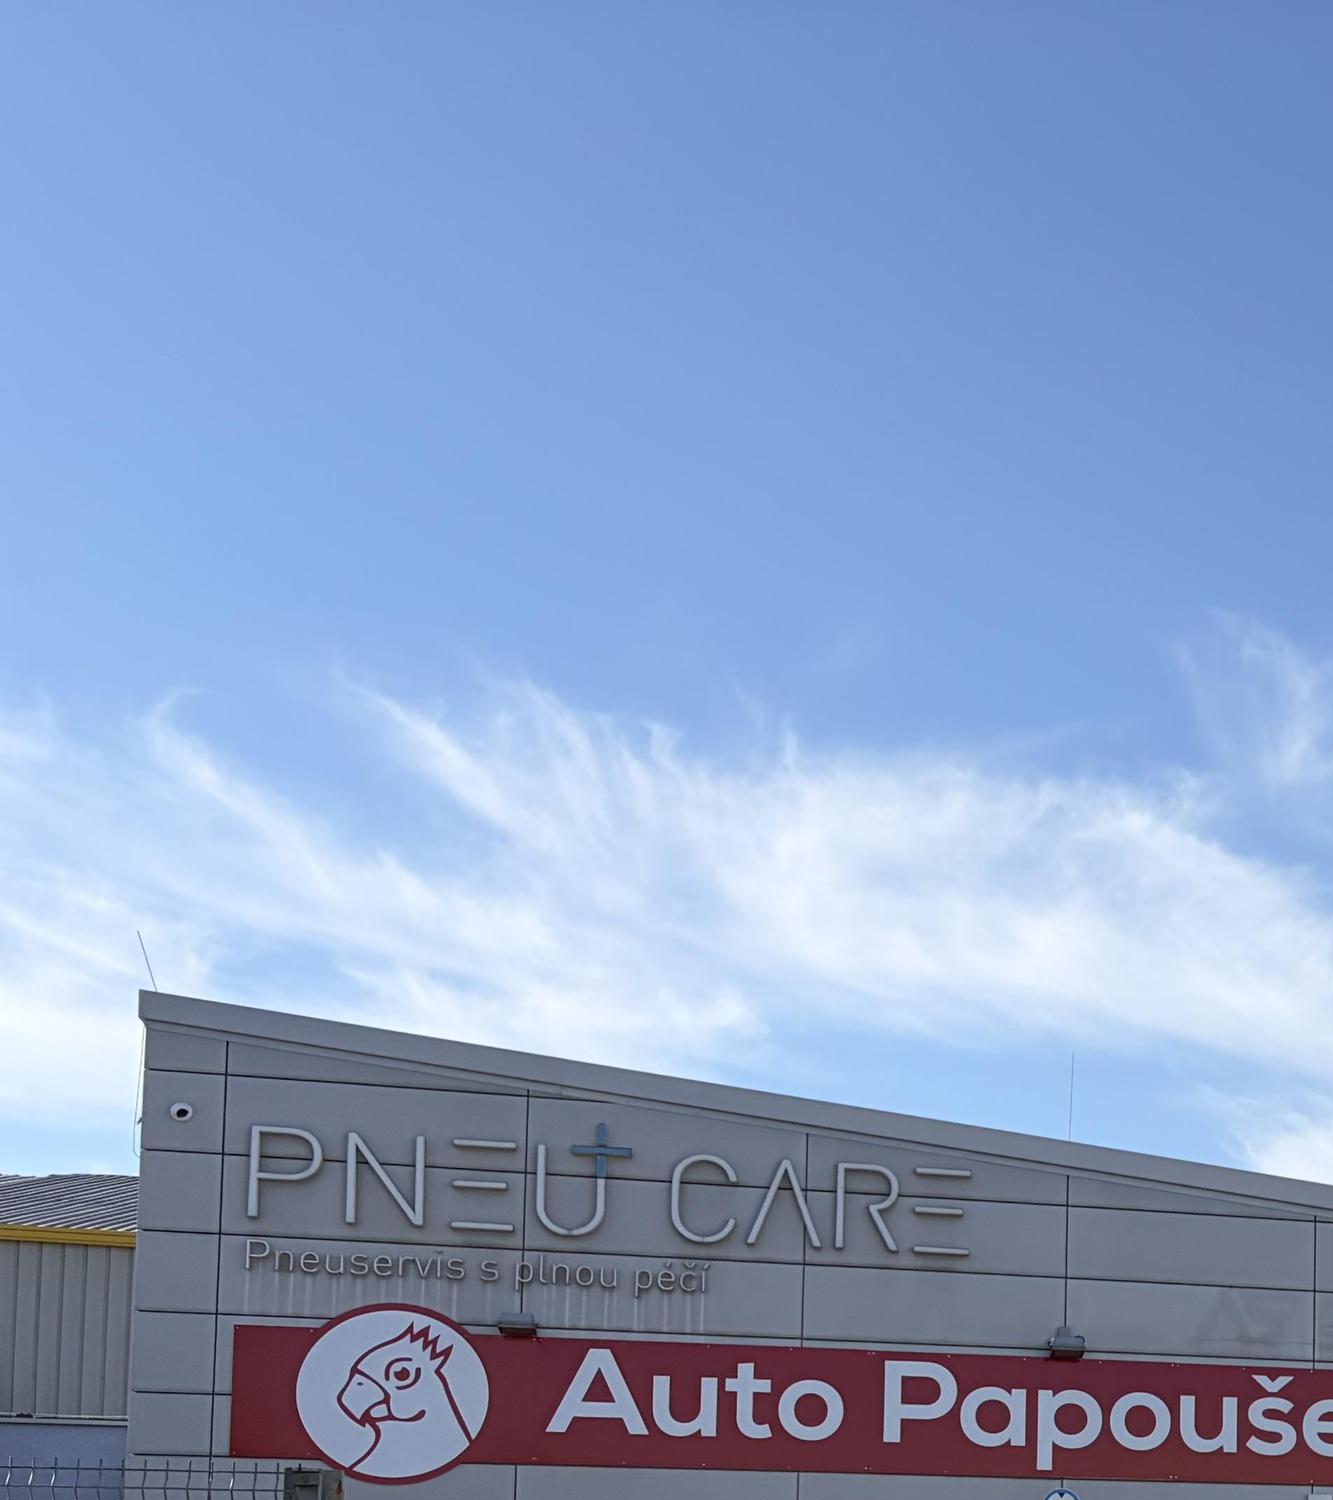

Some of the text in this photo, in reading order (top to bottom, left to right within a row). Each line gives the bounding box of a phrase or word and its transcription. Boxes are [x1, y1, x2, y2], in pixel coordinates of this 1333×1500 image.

[247, 1122, 972, 1257] PNEU CARE
[245, 1239, 711, 1298] Pneuservis s plnou péčí
[546, 1347, 844, 1441] Auto
